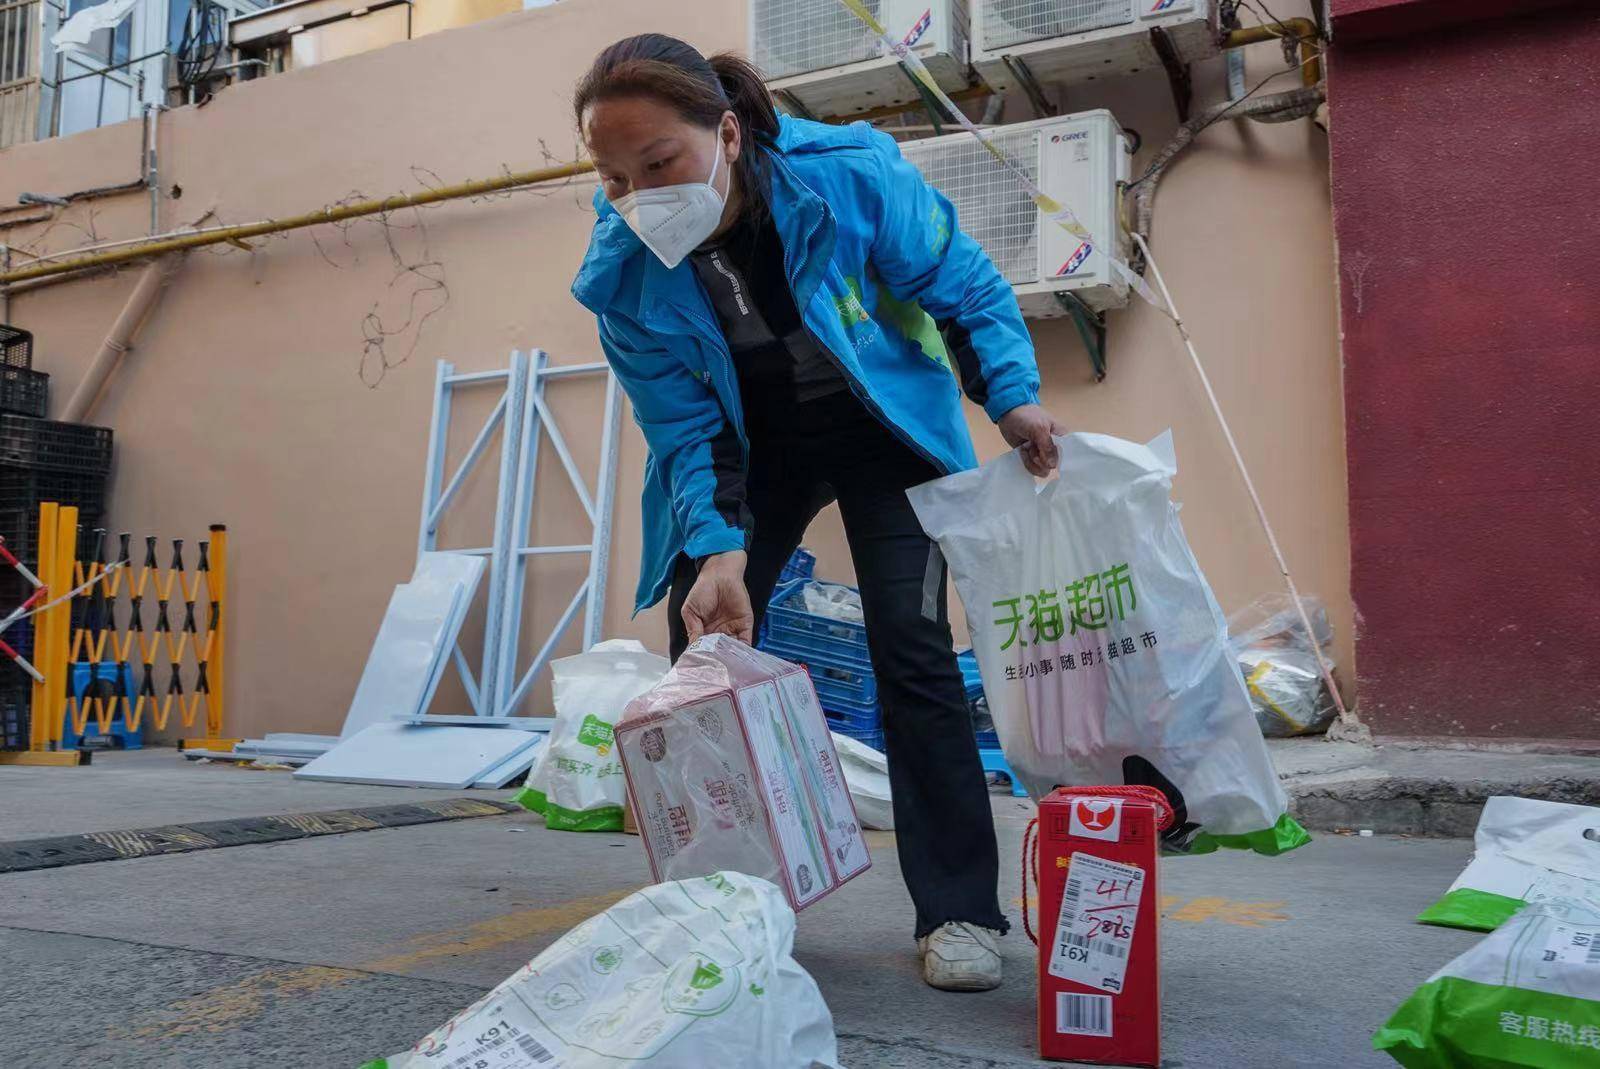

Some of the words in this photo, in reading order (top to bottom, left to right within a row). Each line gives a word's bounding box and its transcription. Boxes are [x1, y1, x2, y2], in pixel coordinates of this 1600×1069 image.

[992, 563, 1137, 651] 天猫超市
[1572, 931, 1592, 947] K91
[1059, 943, 1089, 963] K91
[476, 1020, 510, 1046] K91
